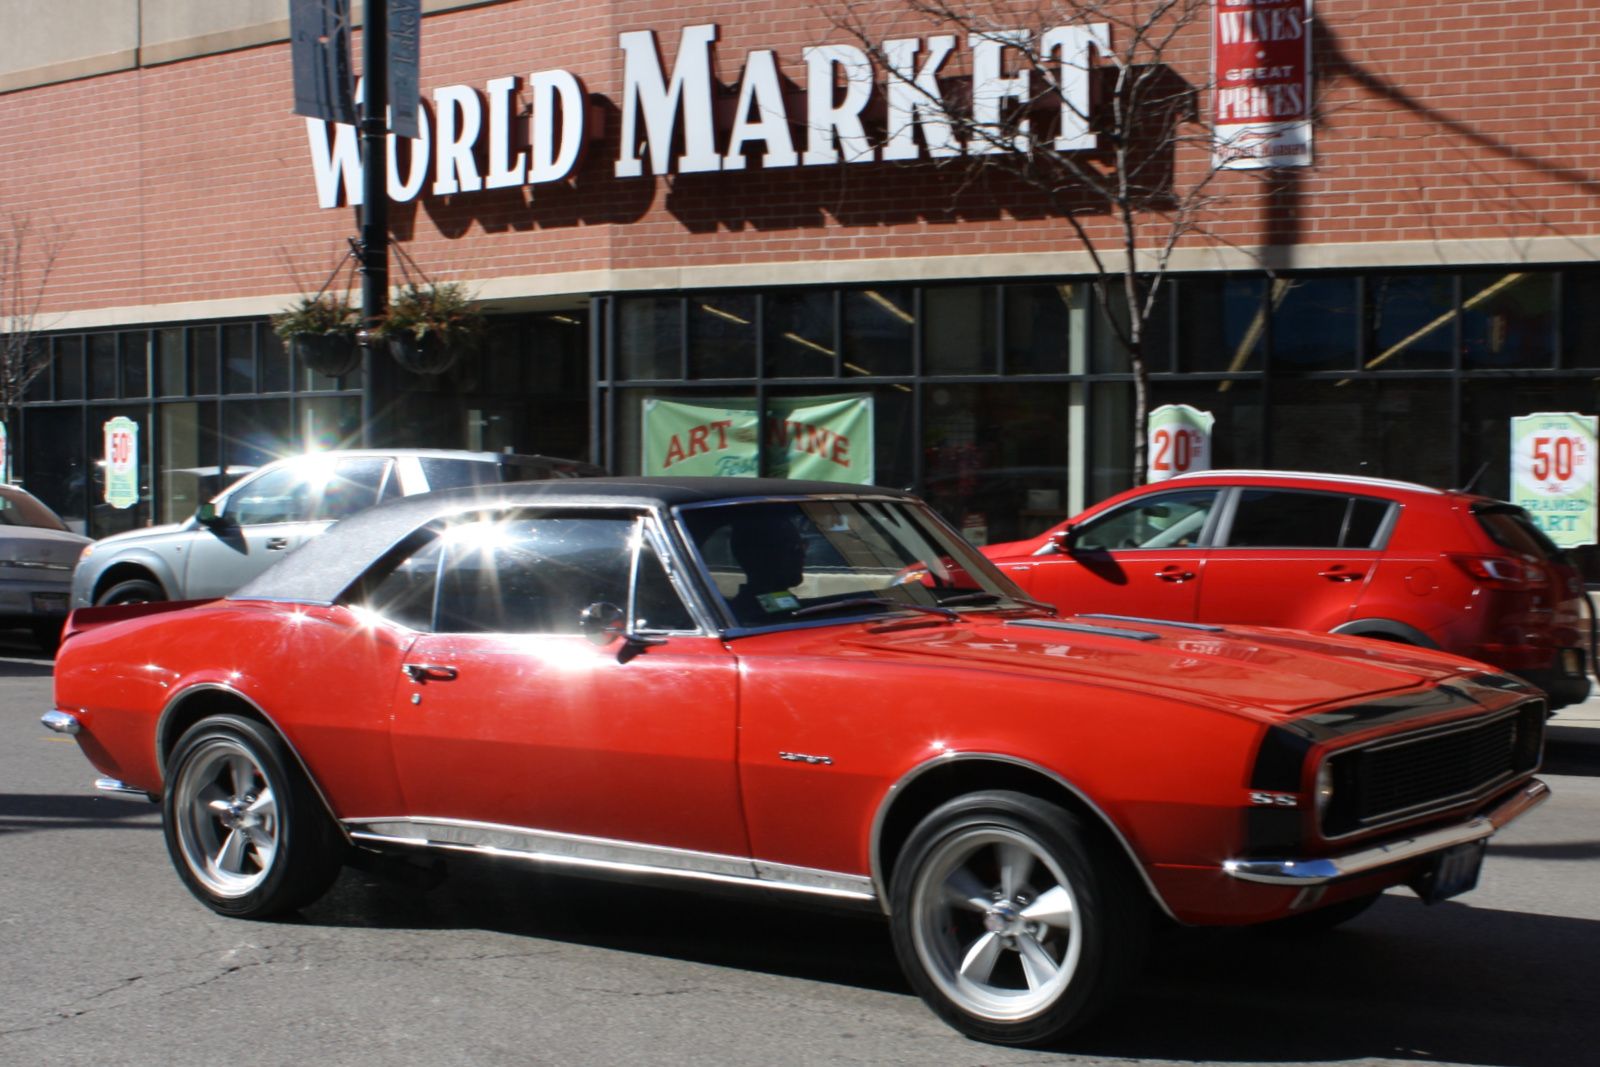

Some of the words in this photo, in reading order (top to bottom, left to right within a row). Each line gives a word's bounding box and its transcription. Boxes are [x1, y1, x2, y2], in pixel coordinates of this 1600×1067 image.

[1219, 7, 1303, 45] WINES
[1225, 65, 1295, 81] GREAT
[304, 69, 584, 209] WORLD
[614, 23, 1111, 178] MARKET
[1217, 84, 1303, 120] PRICES
[663, 419, 732, 469] ART
[1249, 791, 1297, 806] SS
